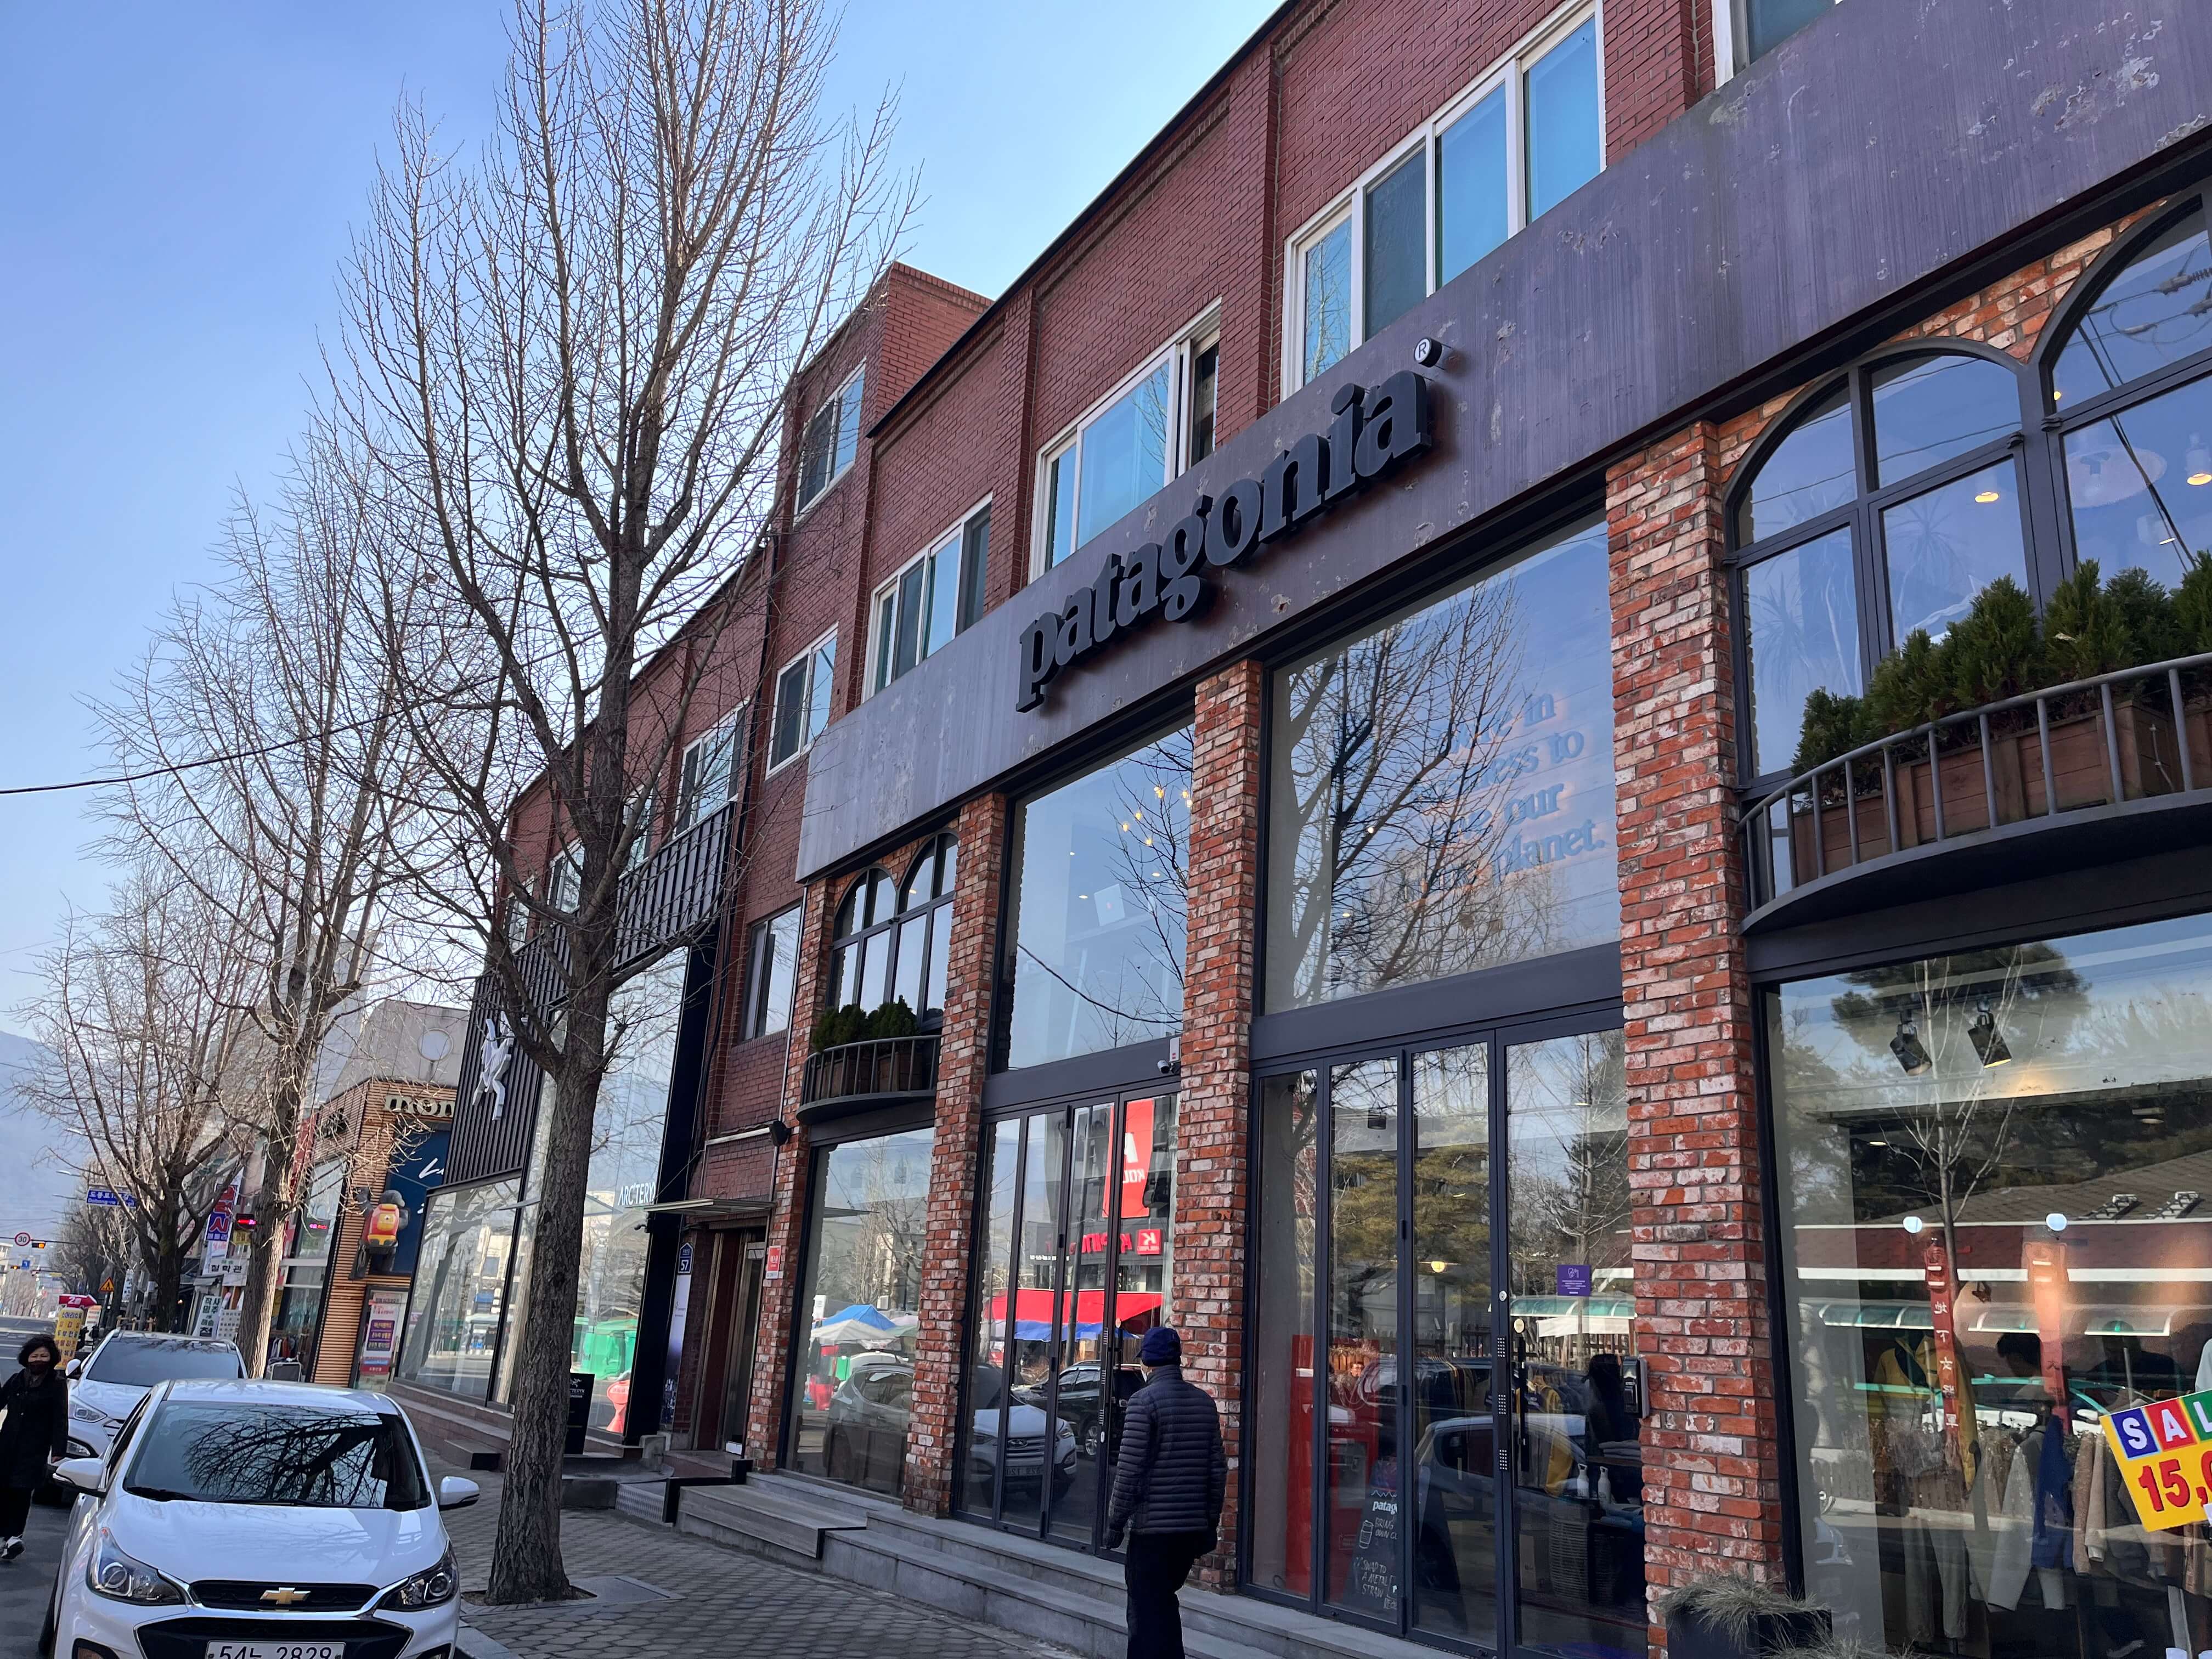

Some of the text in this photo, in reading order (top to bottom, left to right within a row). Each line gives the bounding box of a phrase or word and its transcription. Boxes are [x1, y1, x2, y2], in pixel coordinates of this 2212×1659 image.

[1016, 371, 1431, 713] patagonia
[1550, 731, 1584, 764] to
[1504, 783, 1564, 825] our
[681, 1260, 689, 1271] 57
[1375, 1517, 1394, 1530] BRING
[1362, 1572, 1367, 1583] A
[1362, 1584, 1384, 1598] STRAW
